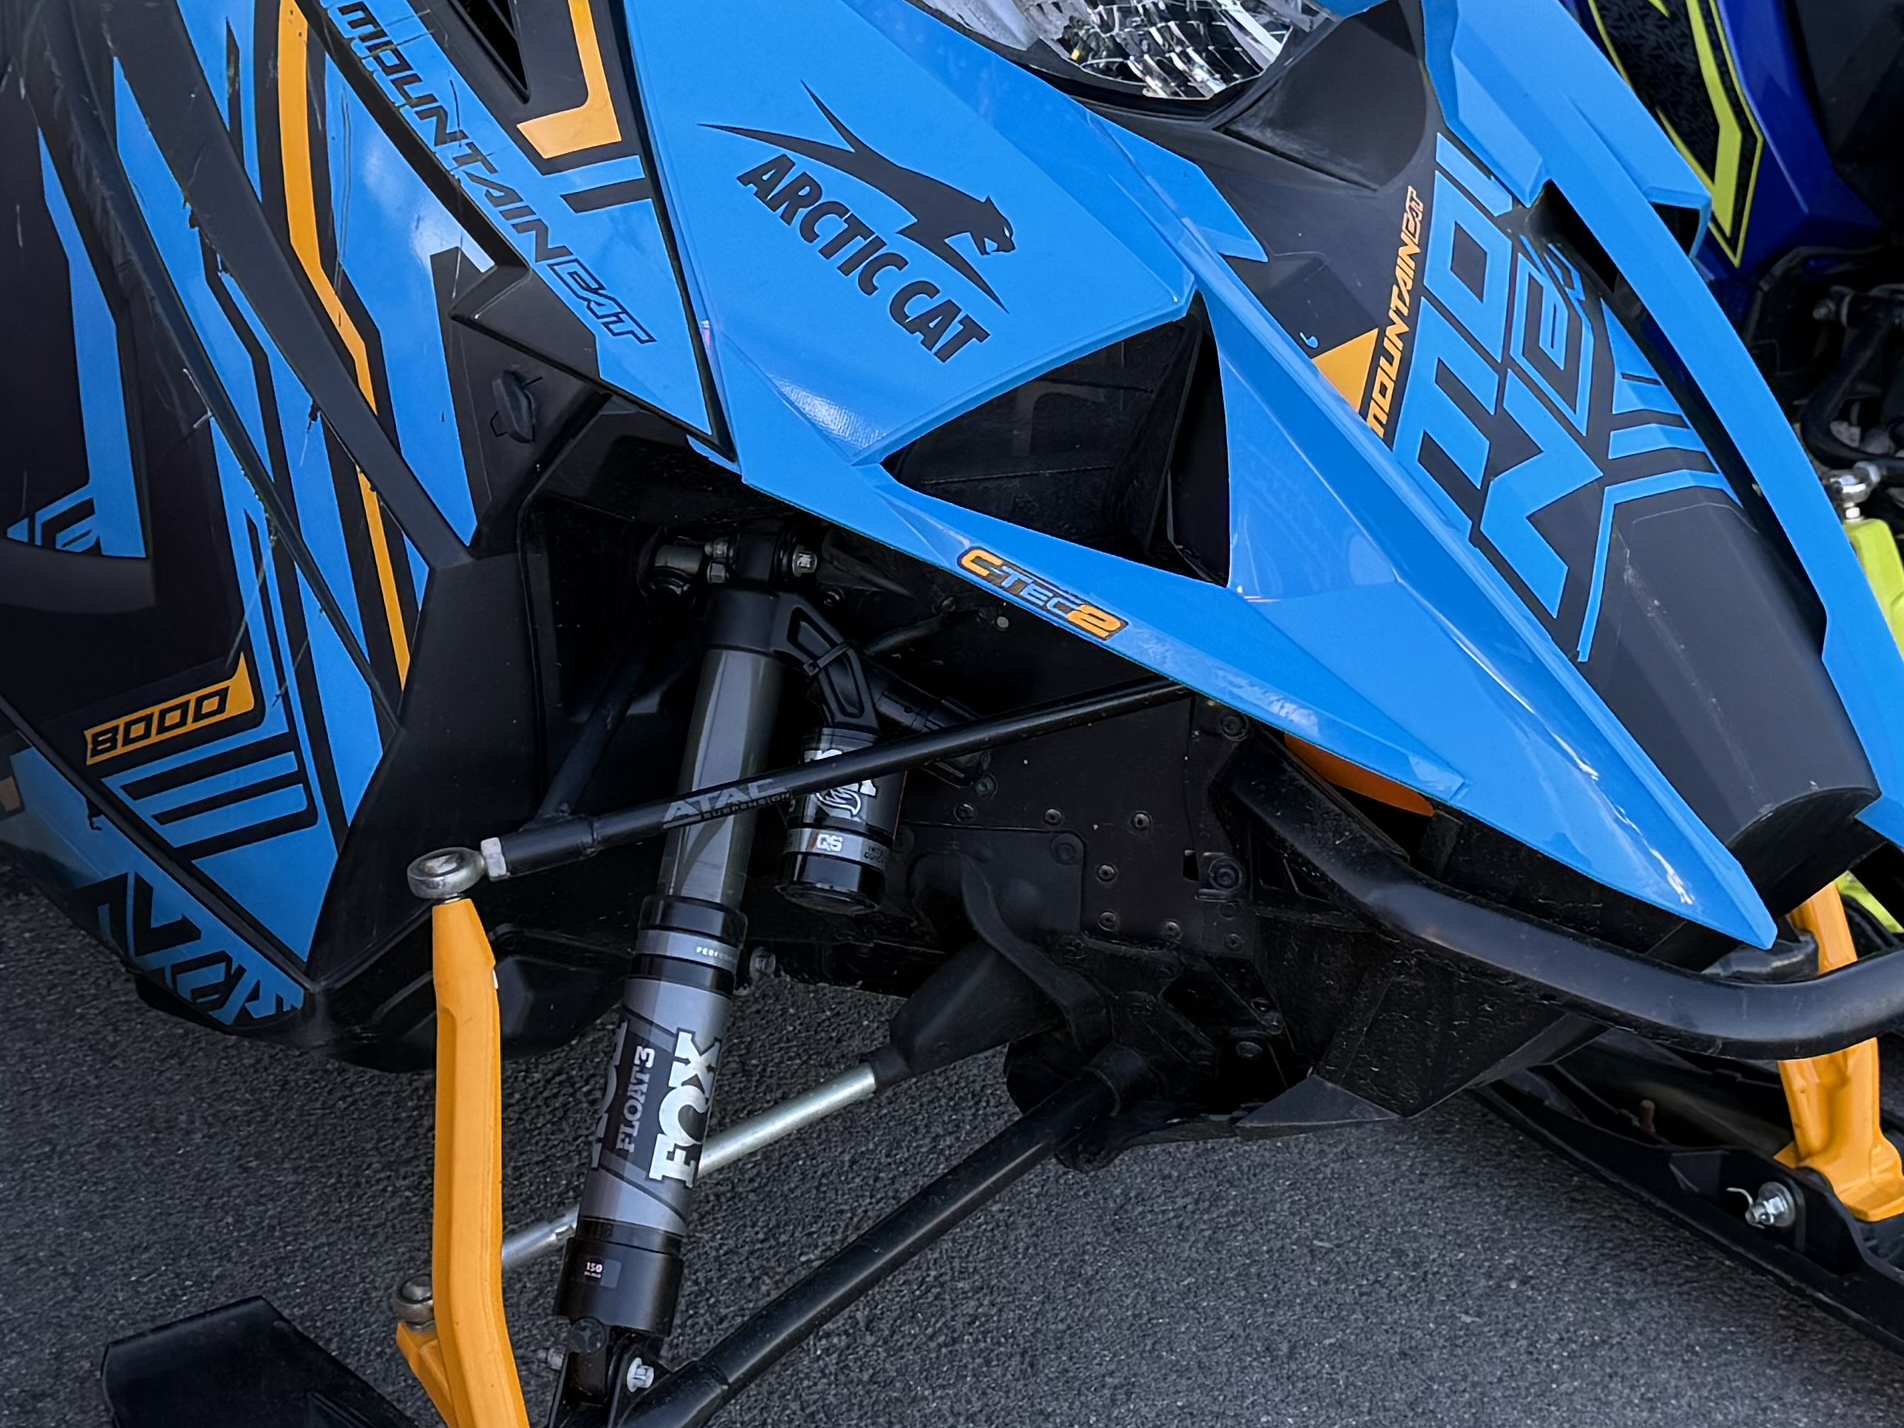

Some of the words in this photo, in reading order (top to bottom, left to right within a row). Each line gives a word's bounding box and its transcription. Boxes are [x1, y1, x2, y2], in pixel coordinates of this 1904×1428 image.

[736, 153, 909, 297] ARCTIC
[889, 280, 991, 363] CAT
[88, 685, 231, 757] 8000
[662, 778, 787, 823] ATAC
[702, 792, 791, 821] SUSPENSION
[649, 1027, 722, 1188] FOX
[586, 1261, 603, 1273] 150
